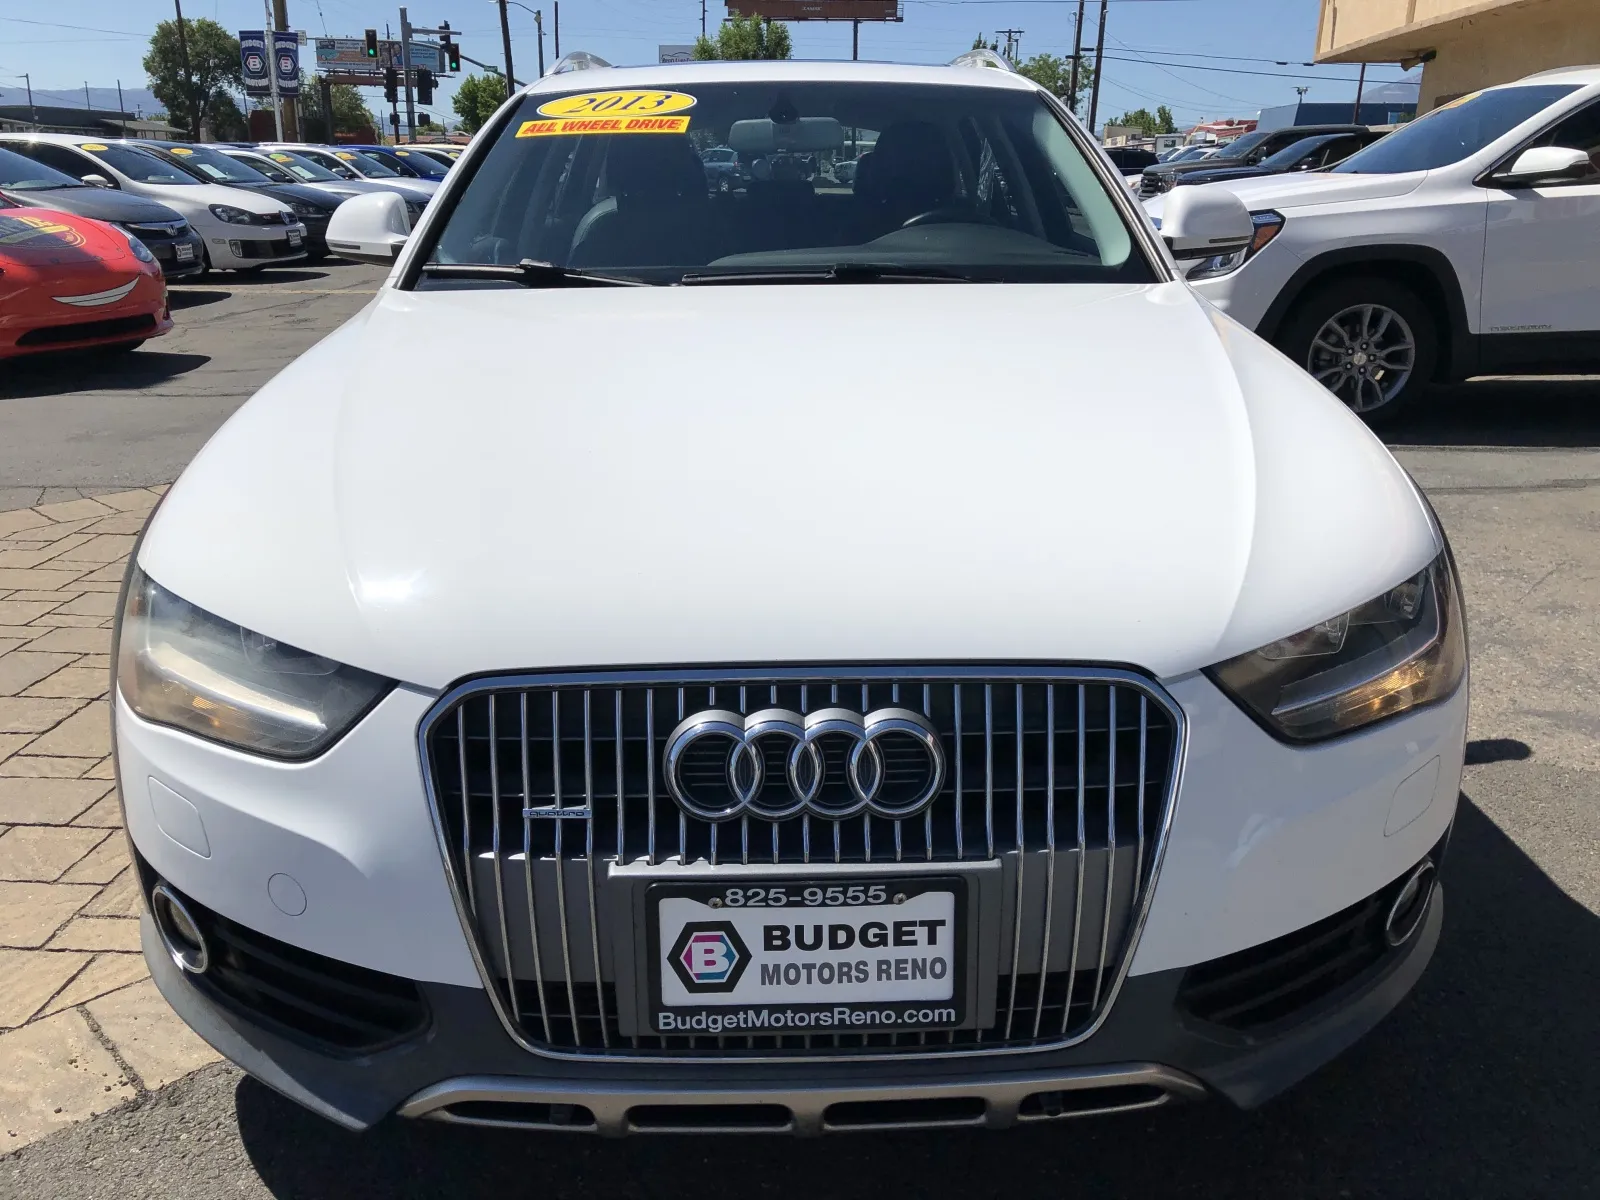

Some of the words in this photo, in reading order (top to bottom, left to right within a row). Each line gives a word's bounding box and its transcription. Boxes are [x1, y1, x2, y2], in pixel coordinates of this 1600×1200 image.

[563, 94, 673, 114] 2013
[522, 122, 557, 135] ALL
[561, 119, 623, 133] WHEEL
[625, 118, 684, 131] DRIVE
[724, 885, 887, 907] 825-9555
[762, 919, 947, 952] BUDGET
[691, 941, 730, 974] B
[760, 960, 869, 986] MOTORS
[876, 957, 948, 982] RENO
[657, 1007, 957, 1033] BudgetMotorsReno.com
